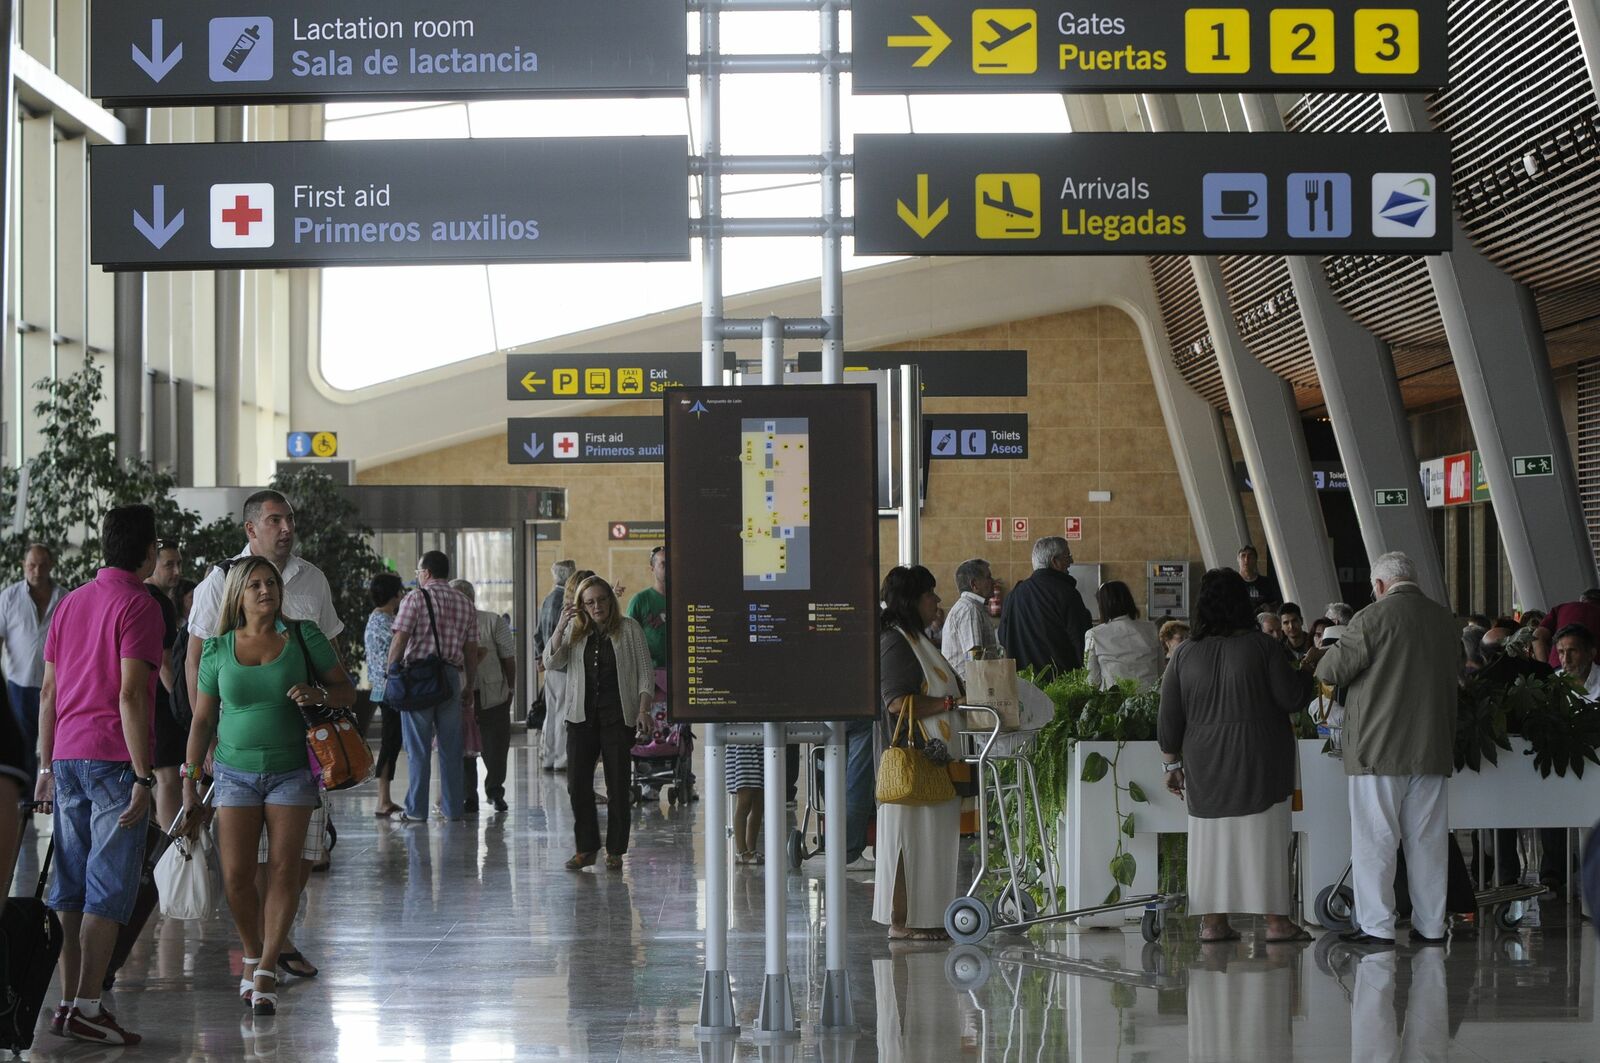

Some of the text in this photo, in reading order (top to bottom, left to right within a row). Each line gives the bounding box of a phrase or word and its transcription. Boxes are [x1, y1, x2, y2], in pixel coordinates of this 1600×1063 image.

[293, 16, 475, 41] Lactation room
[1057, 12, 1126, 35] Gates
[1059, 22, 1401, 71] Puertas 1 2 3
[292, 46, 538, 77] Sala de lactancia
[293, 184, 390, 208] First aid
[1060, 177, 1150, 201] Arrivals
[294, 214, 539, 244] Primeros auxilios
[1061, 208, 1187, 241] Llegadas
[559, 374, 572, 391] P
[650, 369, 668, 380] Exit
[585, 431, 624, 443] First aid
[991, 430, 1021, 441] Toilets
[585, 445, 635, 457] Primeros
[990, 443, 1024, 455] Aseos
